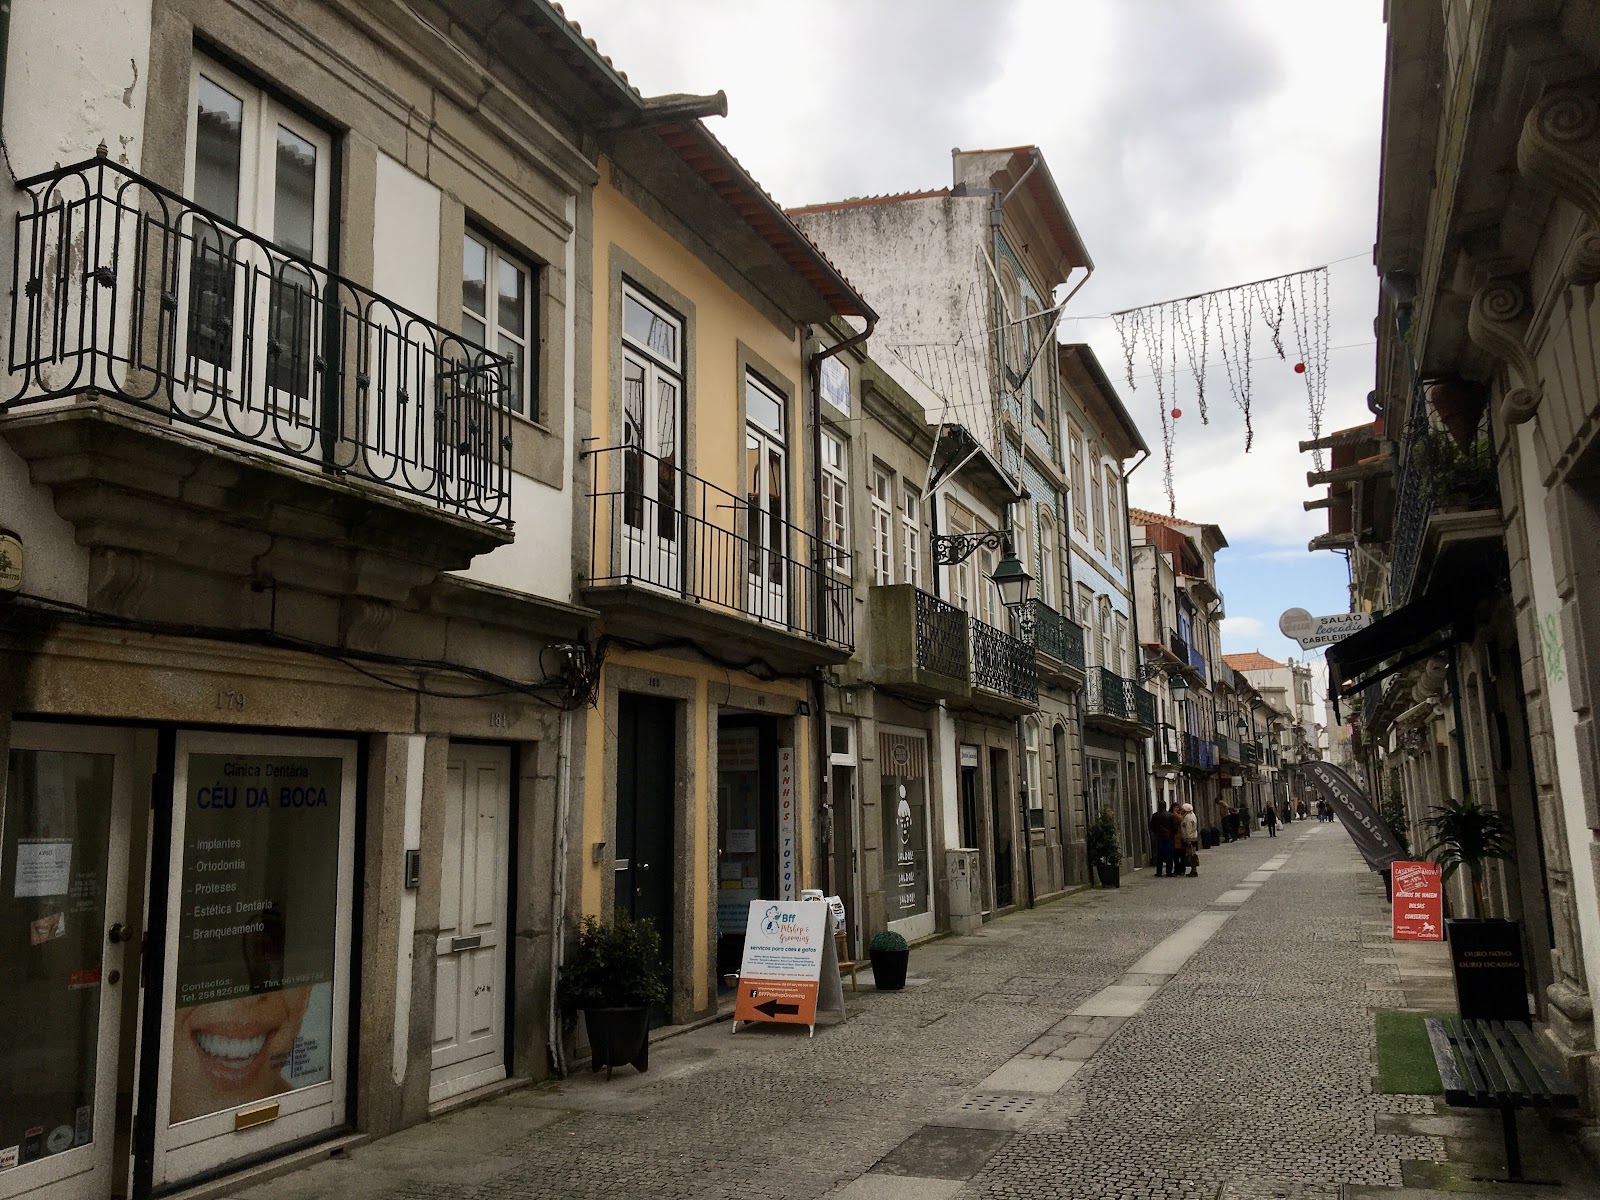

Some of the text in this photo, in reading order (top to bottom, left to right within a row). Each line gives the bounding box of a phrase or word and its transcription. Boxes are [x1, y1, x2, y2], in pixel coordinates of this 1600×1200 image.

[1320, 613, 1362, 624] SALÃO
[1315, 621, 1363, 635] Leocádia
[217, 690, 245, 710] 179
[490, 711, 507, 728] 181
[224, 762, 309, 778] Clínica Dentária
[782, 752, 791, 821] BANHOS
[197, 781, 328, 809] CÉU DA BOCA
[197, 838, 241, 851] Implantes
[196, 858, 246, 872] Ortodontia
[195, 881, 237, 895] Próteses
[194, 899, 274, 918] Estética Dentária
[782, 914, 797, 923] Bff
[193, 921, 265, 941] Branqueamento
[801, 946, 817, 954] gatos
[1463, 950, 1512, 958] OURO NOVO
[181, 977, 233, 993] Contactos:
[181, 993, 197, 1003] Tel.
